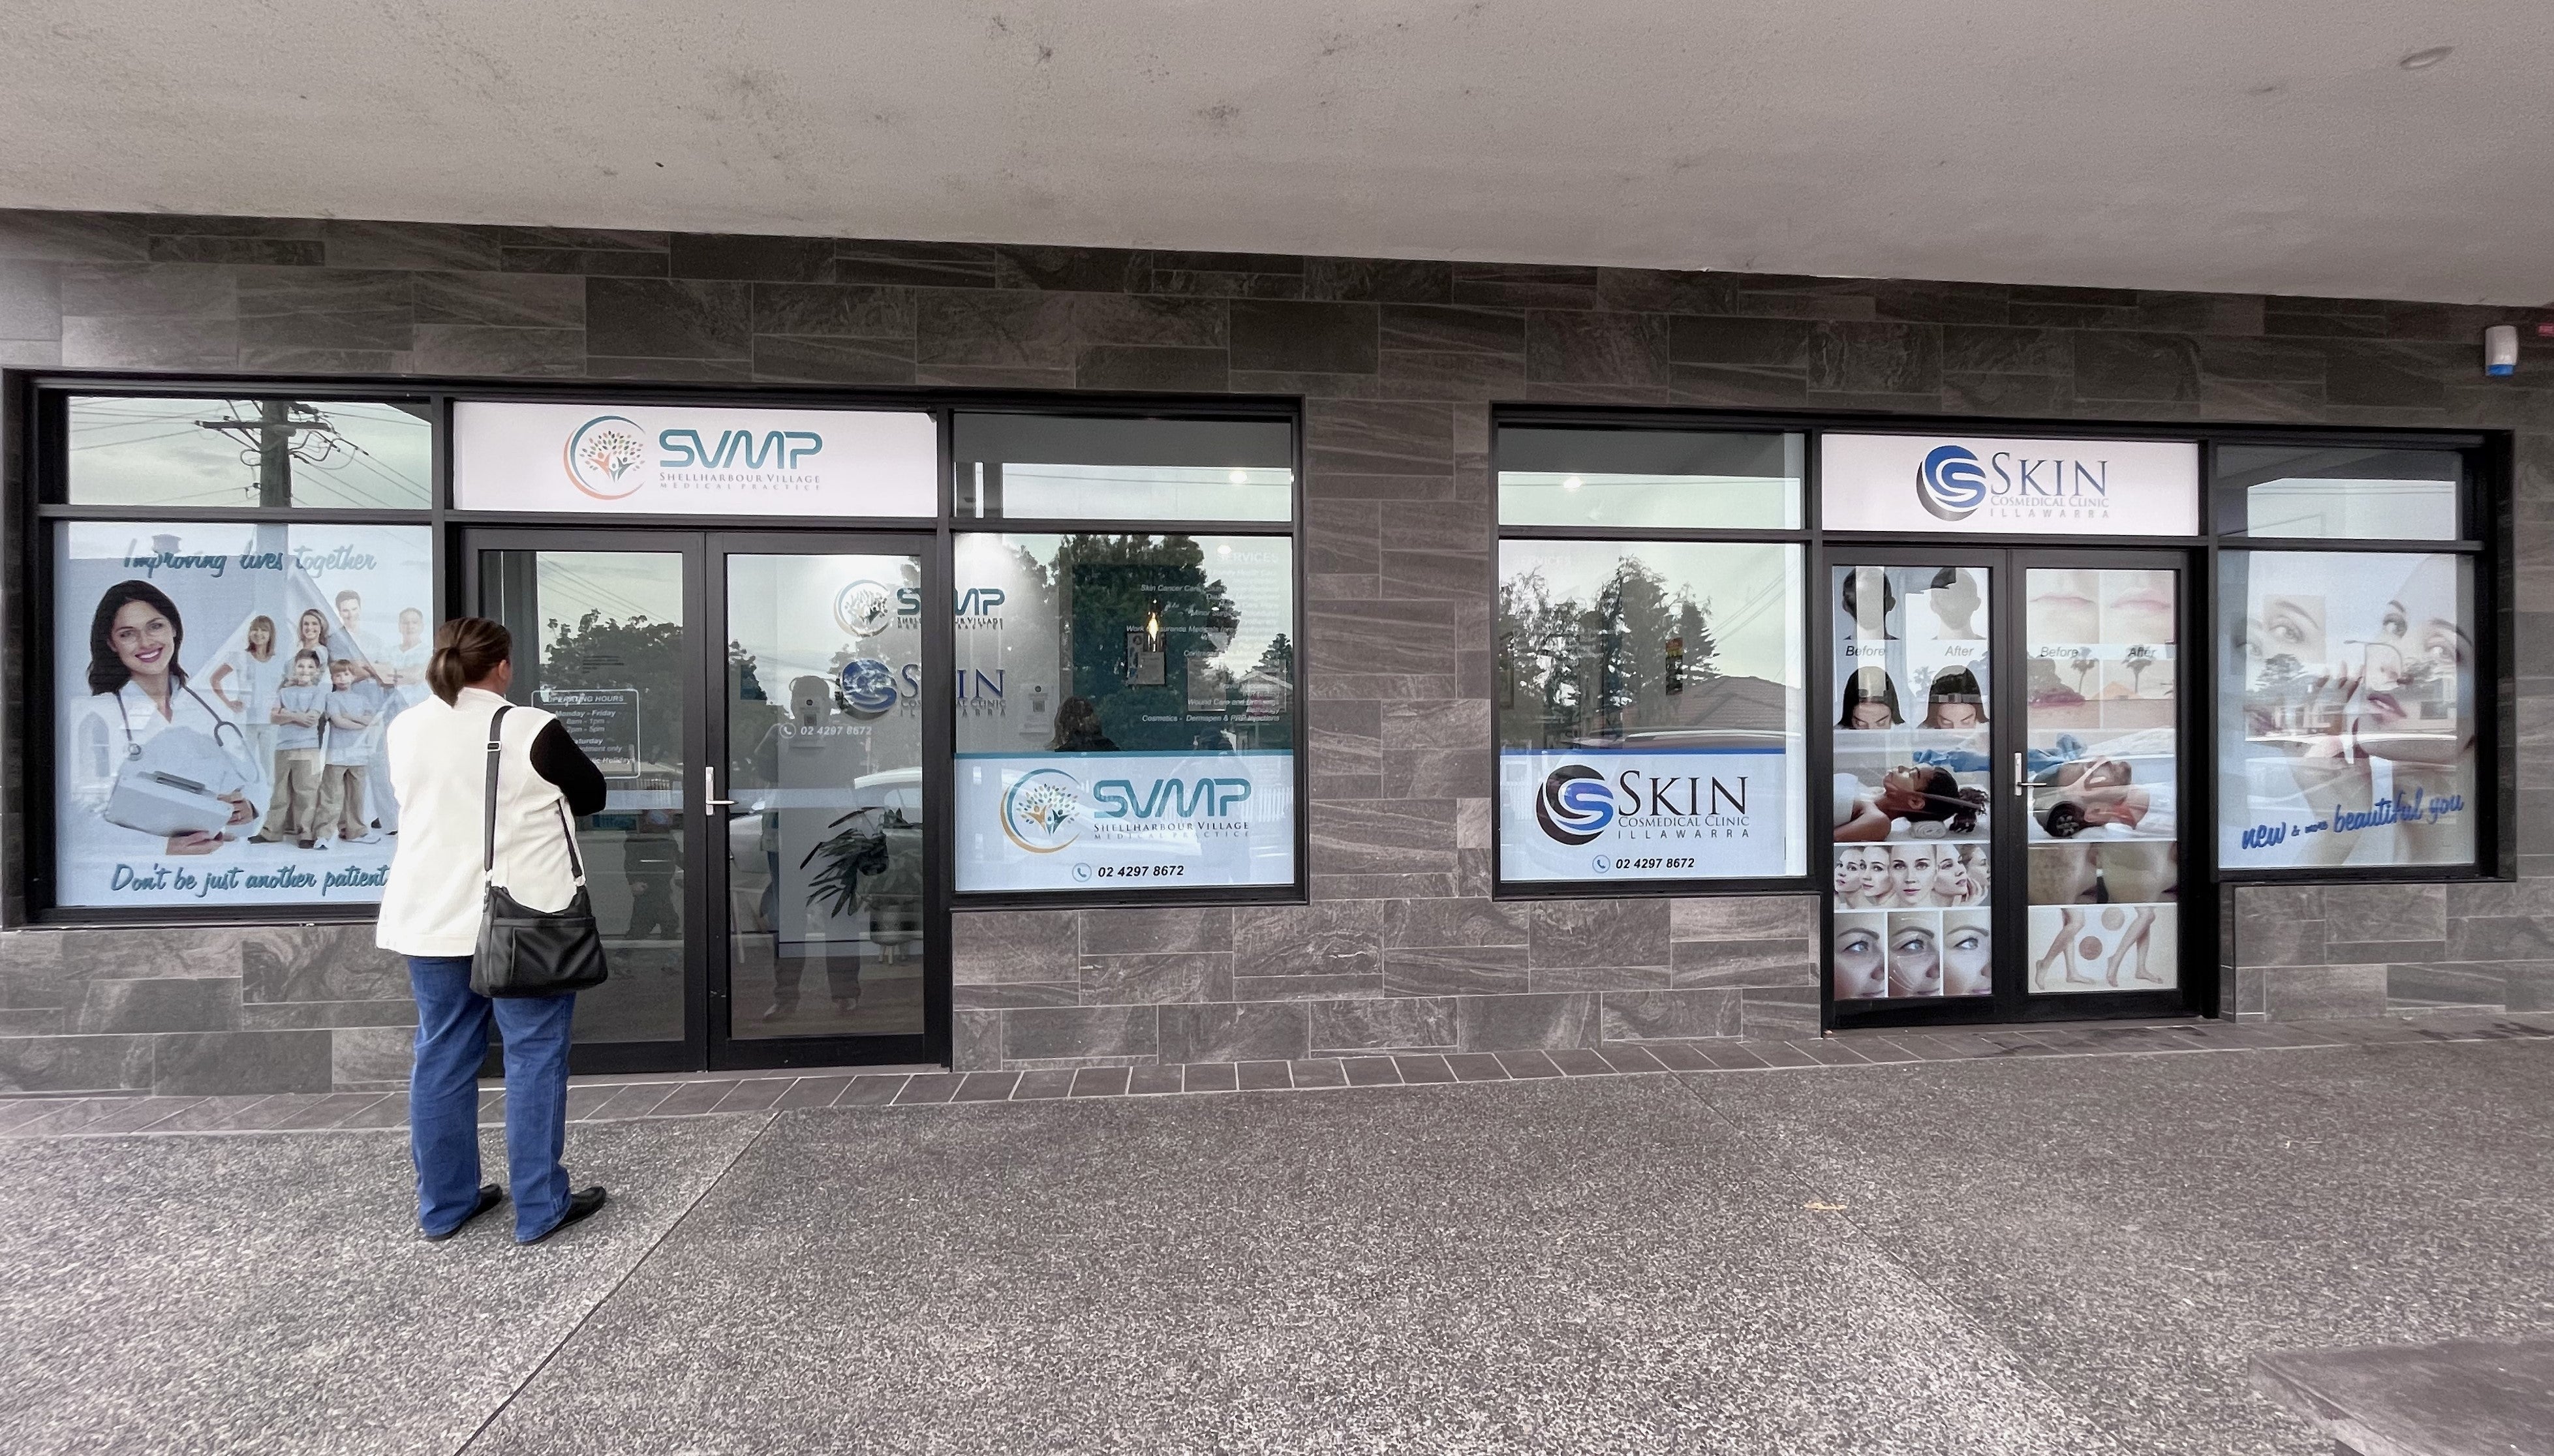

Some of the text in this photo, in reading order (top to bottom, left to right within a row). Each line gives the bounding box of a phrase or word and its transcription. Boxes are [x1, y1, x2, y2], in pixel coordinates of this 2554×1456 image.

[659, 429, 823, 469] SVMP
[660, 472, 820, 483] SHELLHARBOUR VILLAGE
[1991, 451, 2108, 496] SKIN
[1991, 496, 2110, 508] COSMEDICAL CLINIC
[1990, 509, 2109, 519] ILLAWARRA
[123, 538, 377, 578] Improving lives together
[1845, 645, 1974, 657] Before After
[2040, 646, 2157, 658] Before After
[800, 725, 872, 736] 02 4297 8672
[1094, 778, 1252, 818] SVMP
[1618, 770, 1749, 817] SKIN
[1618, 815, 1750, 828] COSMEDICAL CLINIC
[2242, 822, 2286, 849] new
[2333, 787, 2423, 833] beautiful
[2428, 794, 2464, 824] you
[1094, 822, 1249, 832] SHELLHARBOUR VILLAGE
[1618, 828, 1749, 840] ILLAWARRA
[1616, 858, 1695, 869] 02 4297 8672
[1098, 865, 1184, 877] 02 4297 8672
[110, 863, 390, 898] Don't be just another patient
